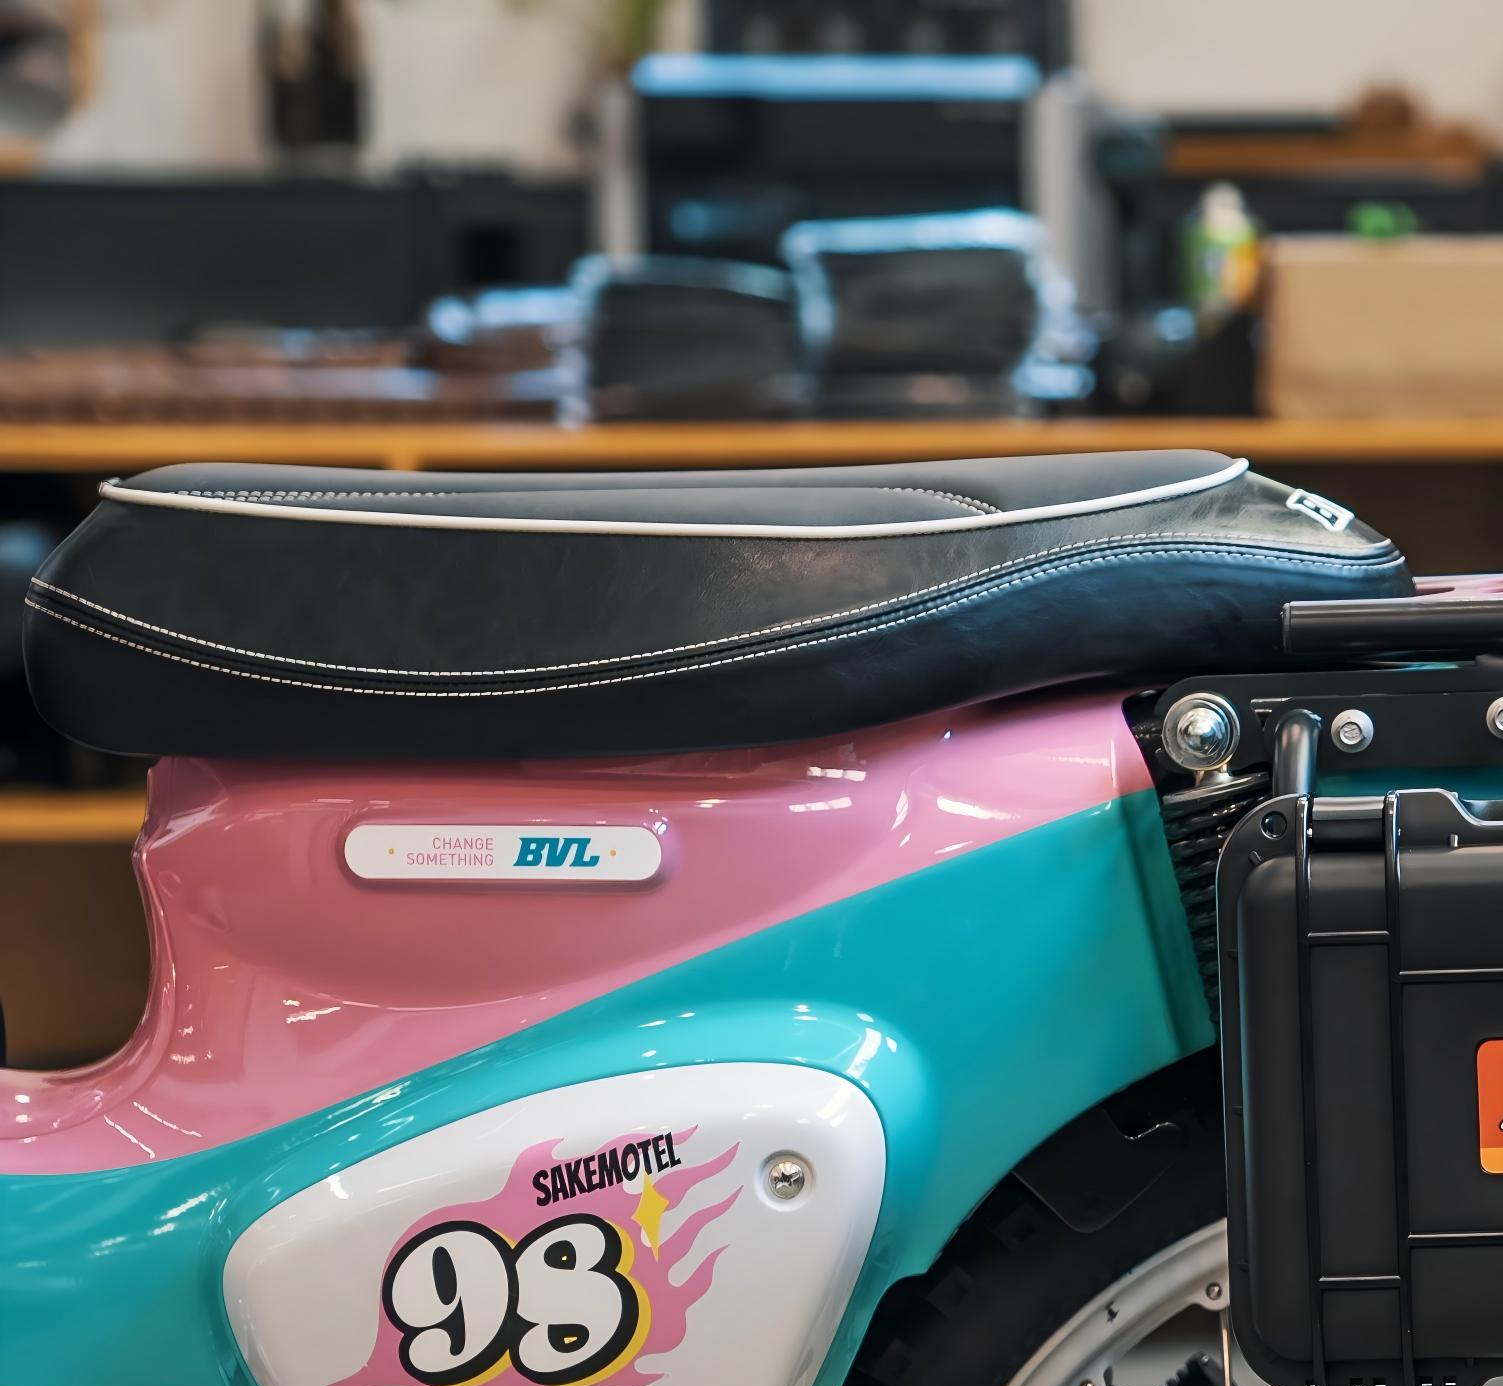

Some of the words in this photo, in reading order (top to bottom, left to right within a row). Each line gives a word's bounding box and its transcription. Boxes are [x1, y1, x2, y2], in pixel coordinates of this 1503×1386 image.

[432, 837, 495, 850] CHANGE
[513, 837, 600, 867] BVL
[406, 852, 494, 867] SOMETHING
[532, 1131, 682, 1207] SAKEMOTEL
